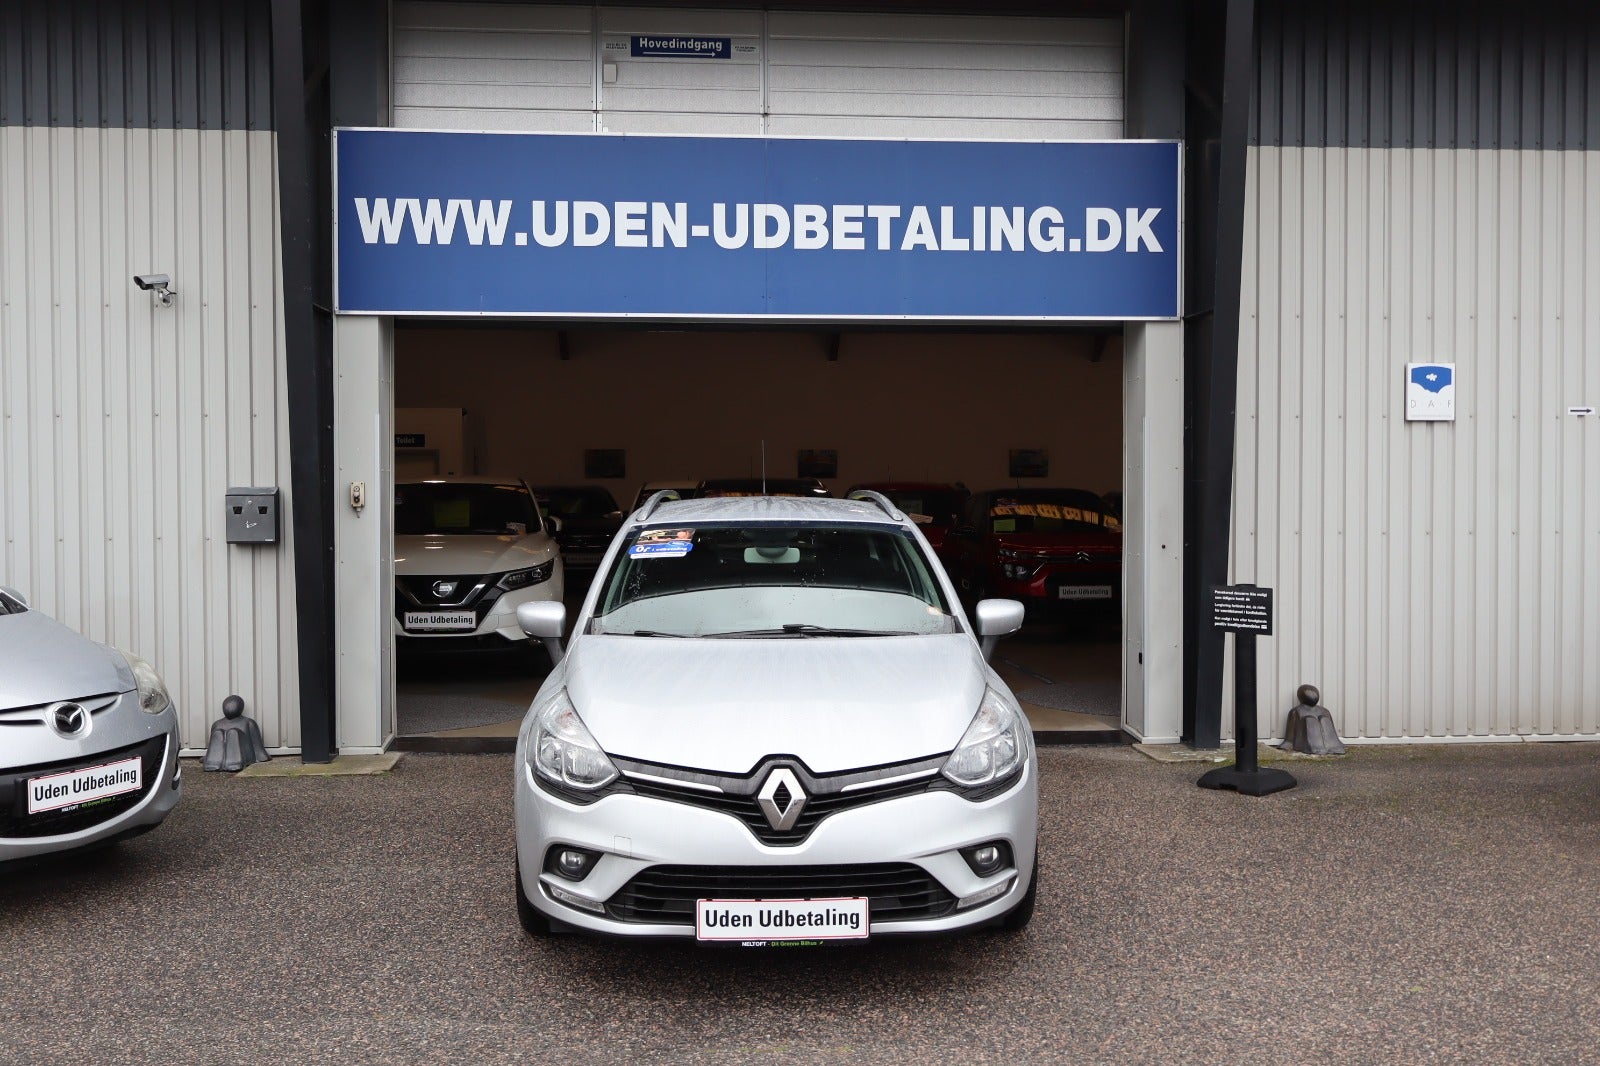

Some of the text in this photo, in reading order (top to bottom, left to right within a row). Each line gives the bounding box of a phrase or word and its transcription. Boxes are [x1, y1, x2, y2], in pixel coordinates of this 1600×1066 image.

[640, 37, 722, 52] Hovedindgang
[354, 197, 1164, 253] WWW.UDEN-UDBETALING.DK
[408, 615, 473, 625] Uden Udbetaling
[34, 769, 137, 802] Uden Udbetaling
[705, 908, 861, 930] Uden Udbetaling
